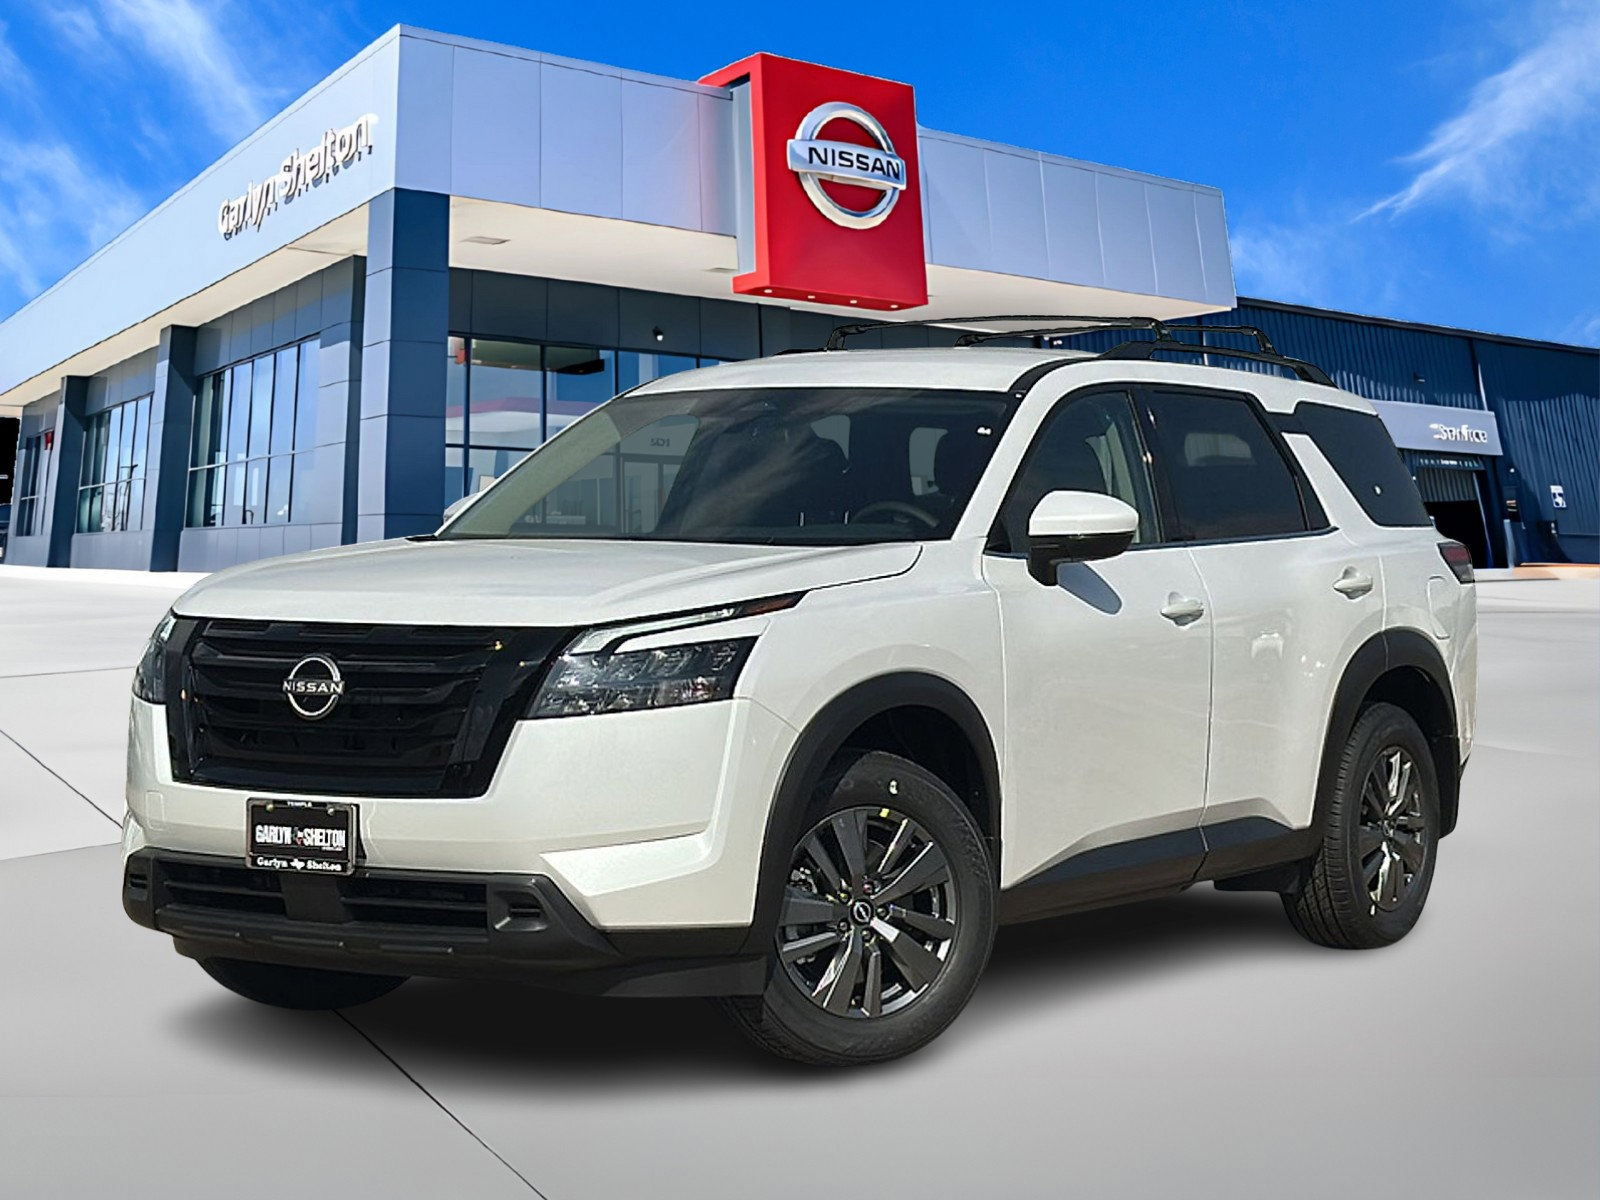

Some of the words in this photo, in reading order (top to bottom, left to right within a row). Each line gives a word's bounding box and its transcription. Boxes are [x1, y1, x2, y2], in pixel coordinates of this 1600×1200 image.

[808, 146, 900, 180] NISSAN
[219, 176, 277, 236] Garlyn
[279, 115, 373, 201] Shelton
[1429, 423, 1488, 443] Service
[283, 680, 345, 695] NISSAN
[255, 824, 292, 844] GARLYN
[303, 828, 346, 848] SHELTON
[257, 857, 289, 870] Garlyn
